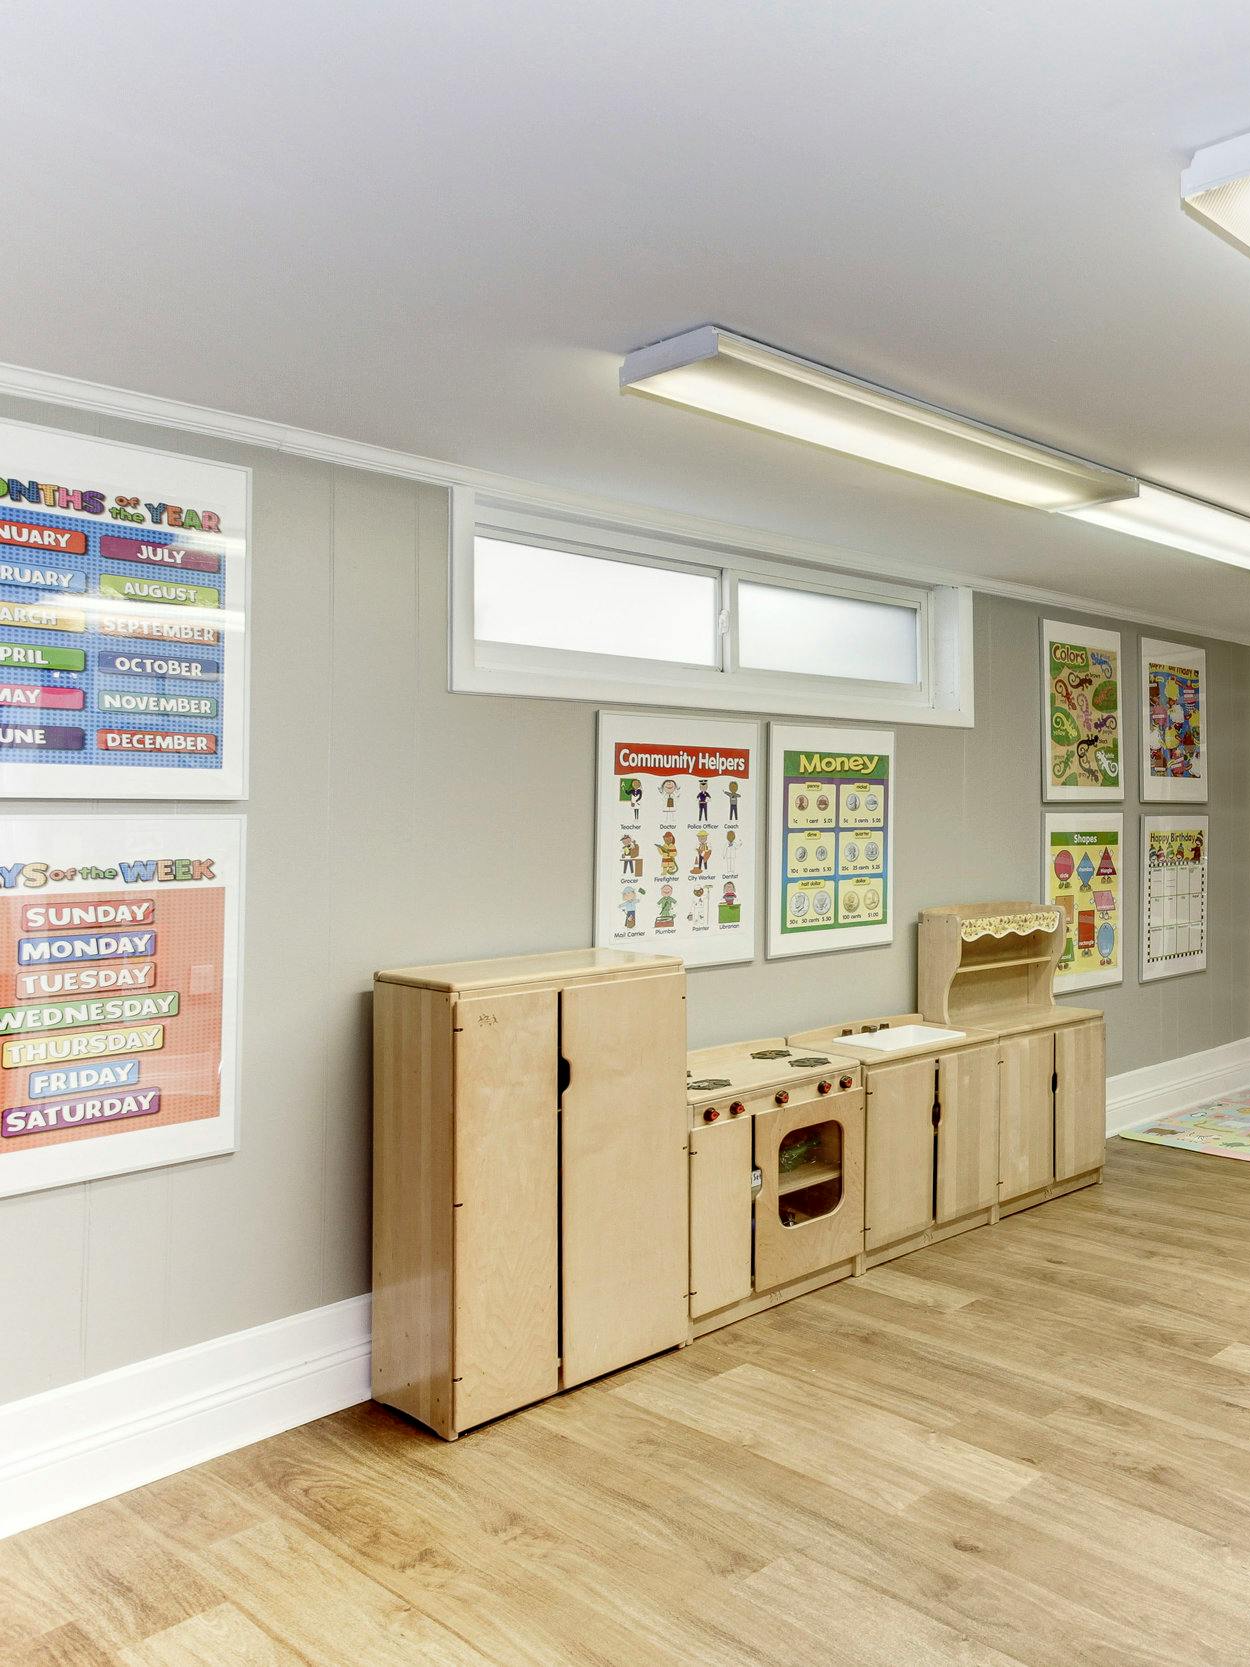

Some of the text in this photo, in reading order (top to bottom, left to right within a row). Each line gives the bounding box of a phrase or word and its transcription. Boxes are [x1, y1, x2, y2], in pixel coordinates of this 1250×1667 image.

[0, 477, 105, 514] NTHS
[109, 507, 145, 524] the
[146, 503, 221, 533] YEAR
[137, 545, 186, 564] JULY
[124, 582, 198, 603] AUGUST
[103, 617, 215, 641] SEPTEMBER
[1052, 644, 1086, 665] Colors
[115, 658, 203, 678] OCTOBER
[104, 694, 212, 715] NOVEMBER
[106, 733, 208, 751] DECEMBER
[620, 749, 746, 775] Community Helpers
[799, 754, 880, 775] Money
[1074, 834, 1098, 845] Shapes
[1150, 832, 1196, 844] Happy Birthday
[0, 858, 216, 888] YS of the WEEK
[26, 902, 151, 927] SUNDAY
[22, 934, 153, 961] MONDAY
[21, 965, 152, 994] TUESDAY
[0, 995, 176, 1031] WEDNESDAY
[8, 1027, 161, 1064] THURSDAY
[33, 1063, 137, 1095] FRIDAY
[6, 1091, 156, 1133] SATURDAY
